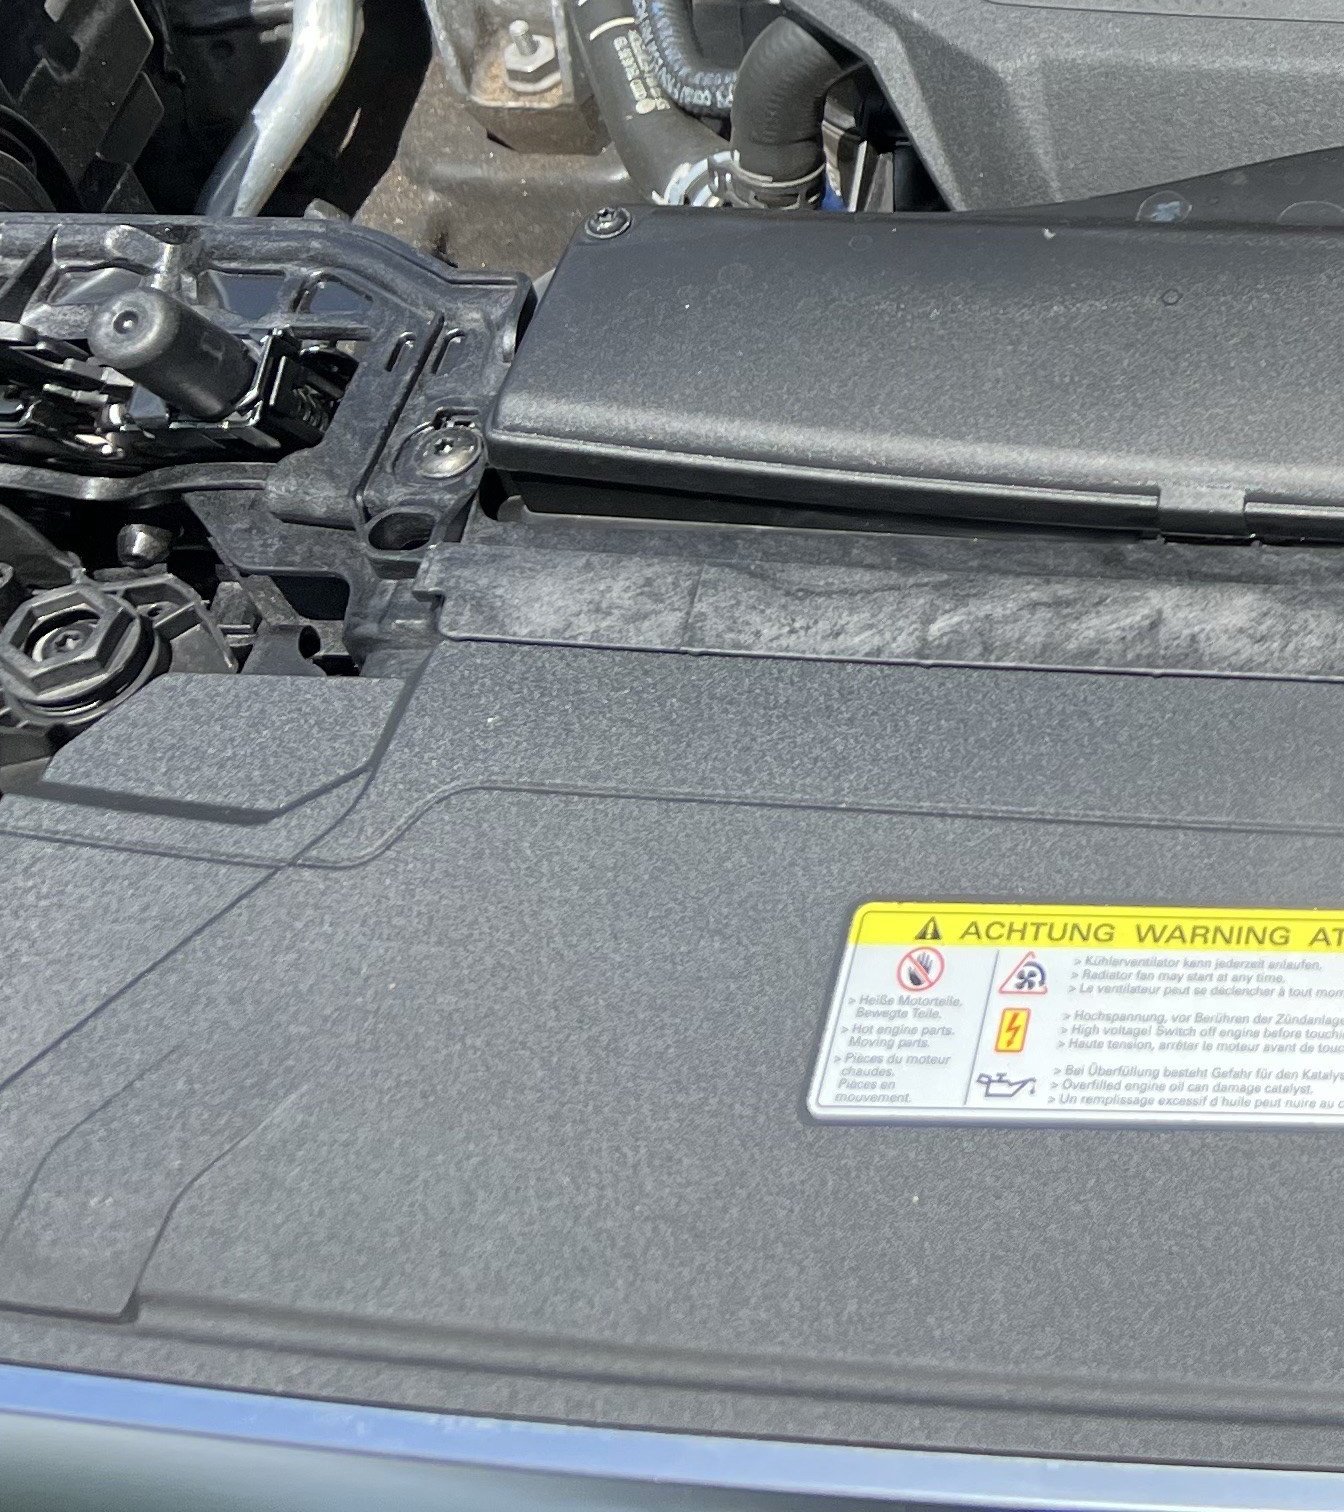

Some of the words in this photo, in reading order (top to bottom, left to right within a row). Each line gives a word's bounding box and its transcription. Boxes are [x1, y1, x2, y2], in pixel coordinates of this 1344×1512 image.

[960, 920, 1115, 944] ACHTUNG
[1135, 922, 1292, 947] WARNING
[1182, 957, 1211, 969] kann
[1214, 958, 1264, 972] jederzeit
[1081, 969, 1132, 980] Radiator
[1135, 970, 1154, 981] fan
[1158, 972, 1183, 982] may
[1186, 972, 1213, 982] start
[1216, 973, 1227, 982] at
[1231, 974, 1253, 985] any
[1078, 982, 1093, 993] Le
[1097, 983, 1160, 995] ventilateur
[1163, 986, 1190, 996] peut
[1192, 987, 1206, 996] se
[1288, 987, 1312, 998] tout
[858, 994, 894, 1006] Heiße
[855, 1007, 907, 1020] Bewegte
[1073, 1010, 1167, 1025] Hochspannung,
[1170, 1014, 1191, 1023] vor
[1194, 1012, 1248, 1023] Berühren
[1252, 1013, 1272, 1025] der
[1275, 1013, 1344, 1027] Zündanlage
[850, 1023, 873, 1034] Hot
[876, 1024, 917, 1036] engine
[920, 1026, 955, 1036] parts.
[1070, 1024, 1099, 1037] High
[1155, 1025, 1195, 1037] Switch
[1199, 1026, 1216, 1038] off
[1218, 1028, 1259, 1039] engine
[1263, 1027, 1301, 1039] before
[848, 1035, 895, 1048] Moving
[896, 1036, 931, 1049] parts.
[1066, 1038, 1103, 1050] Haute
[1107, 1038, 1155, 1052] tension,
[1201, 1040, 1212, 1052] le
[1216, 1039, 1259, 1053] moteur
[1263, 1043, 1296, 1053] avant
[1299, 1042, 1314, 1053] de
[886, 1053, 902, 1064] du
[906, 1055, 950, 1065] moteur
[1064, 1064, 1084, 1076] Bei
[1163, 1066, 1207, 1078] besteht
[1210, 1067, 1251, 1078] Gefahr
[1255, 1068, 1272, 1079] für
[1275, 1069, 1298, 1079] den
[879, 1081, 895, 1089] en
[1061, 1078, 1121, 1090] Overfilled
[1124, 1080, 1165, 1093] engine
[1168, 1081, 1184, 1092] oil
[1186, 1084, 1208, 1095] can
[1212, 1082, 1260, 1095] damage
[1058, 1093, 1076, 1104] Un
[1080, 1094, 1154, 1107] remplissage
[1158, 1095, 1207, 1106] excessif
[1254, 1098, 1280, 1108] peut
[1284, 1100, 1316, 1108] nuire
[1319, 1100, 1333, 1108] au
